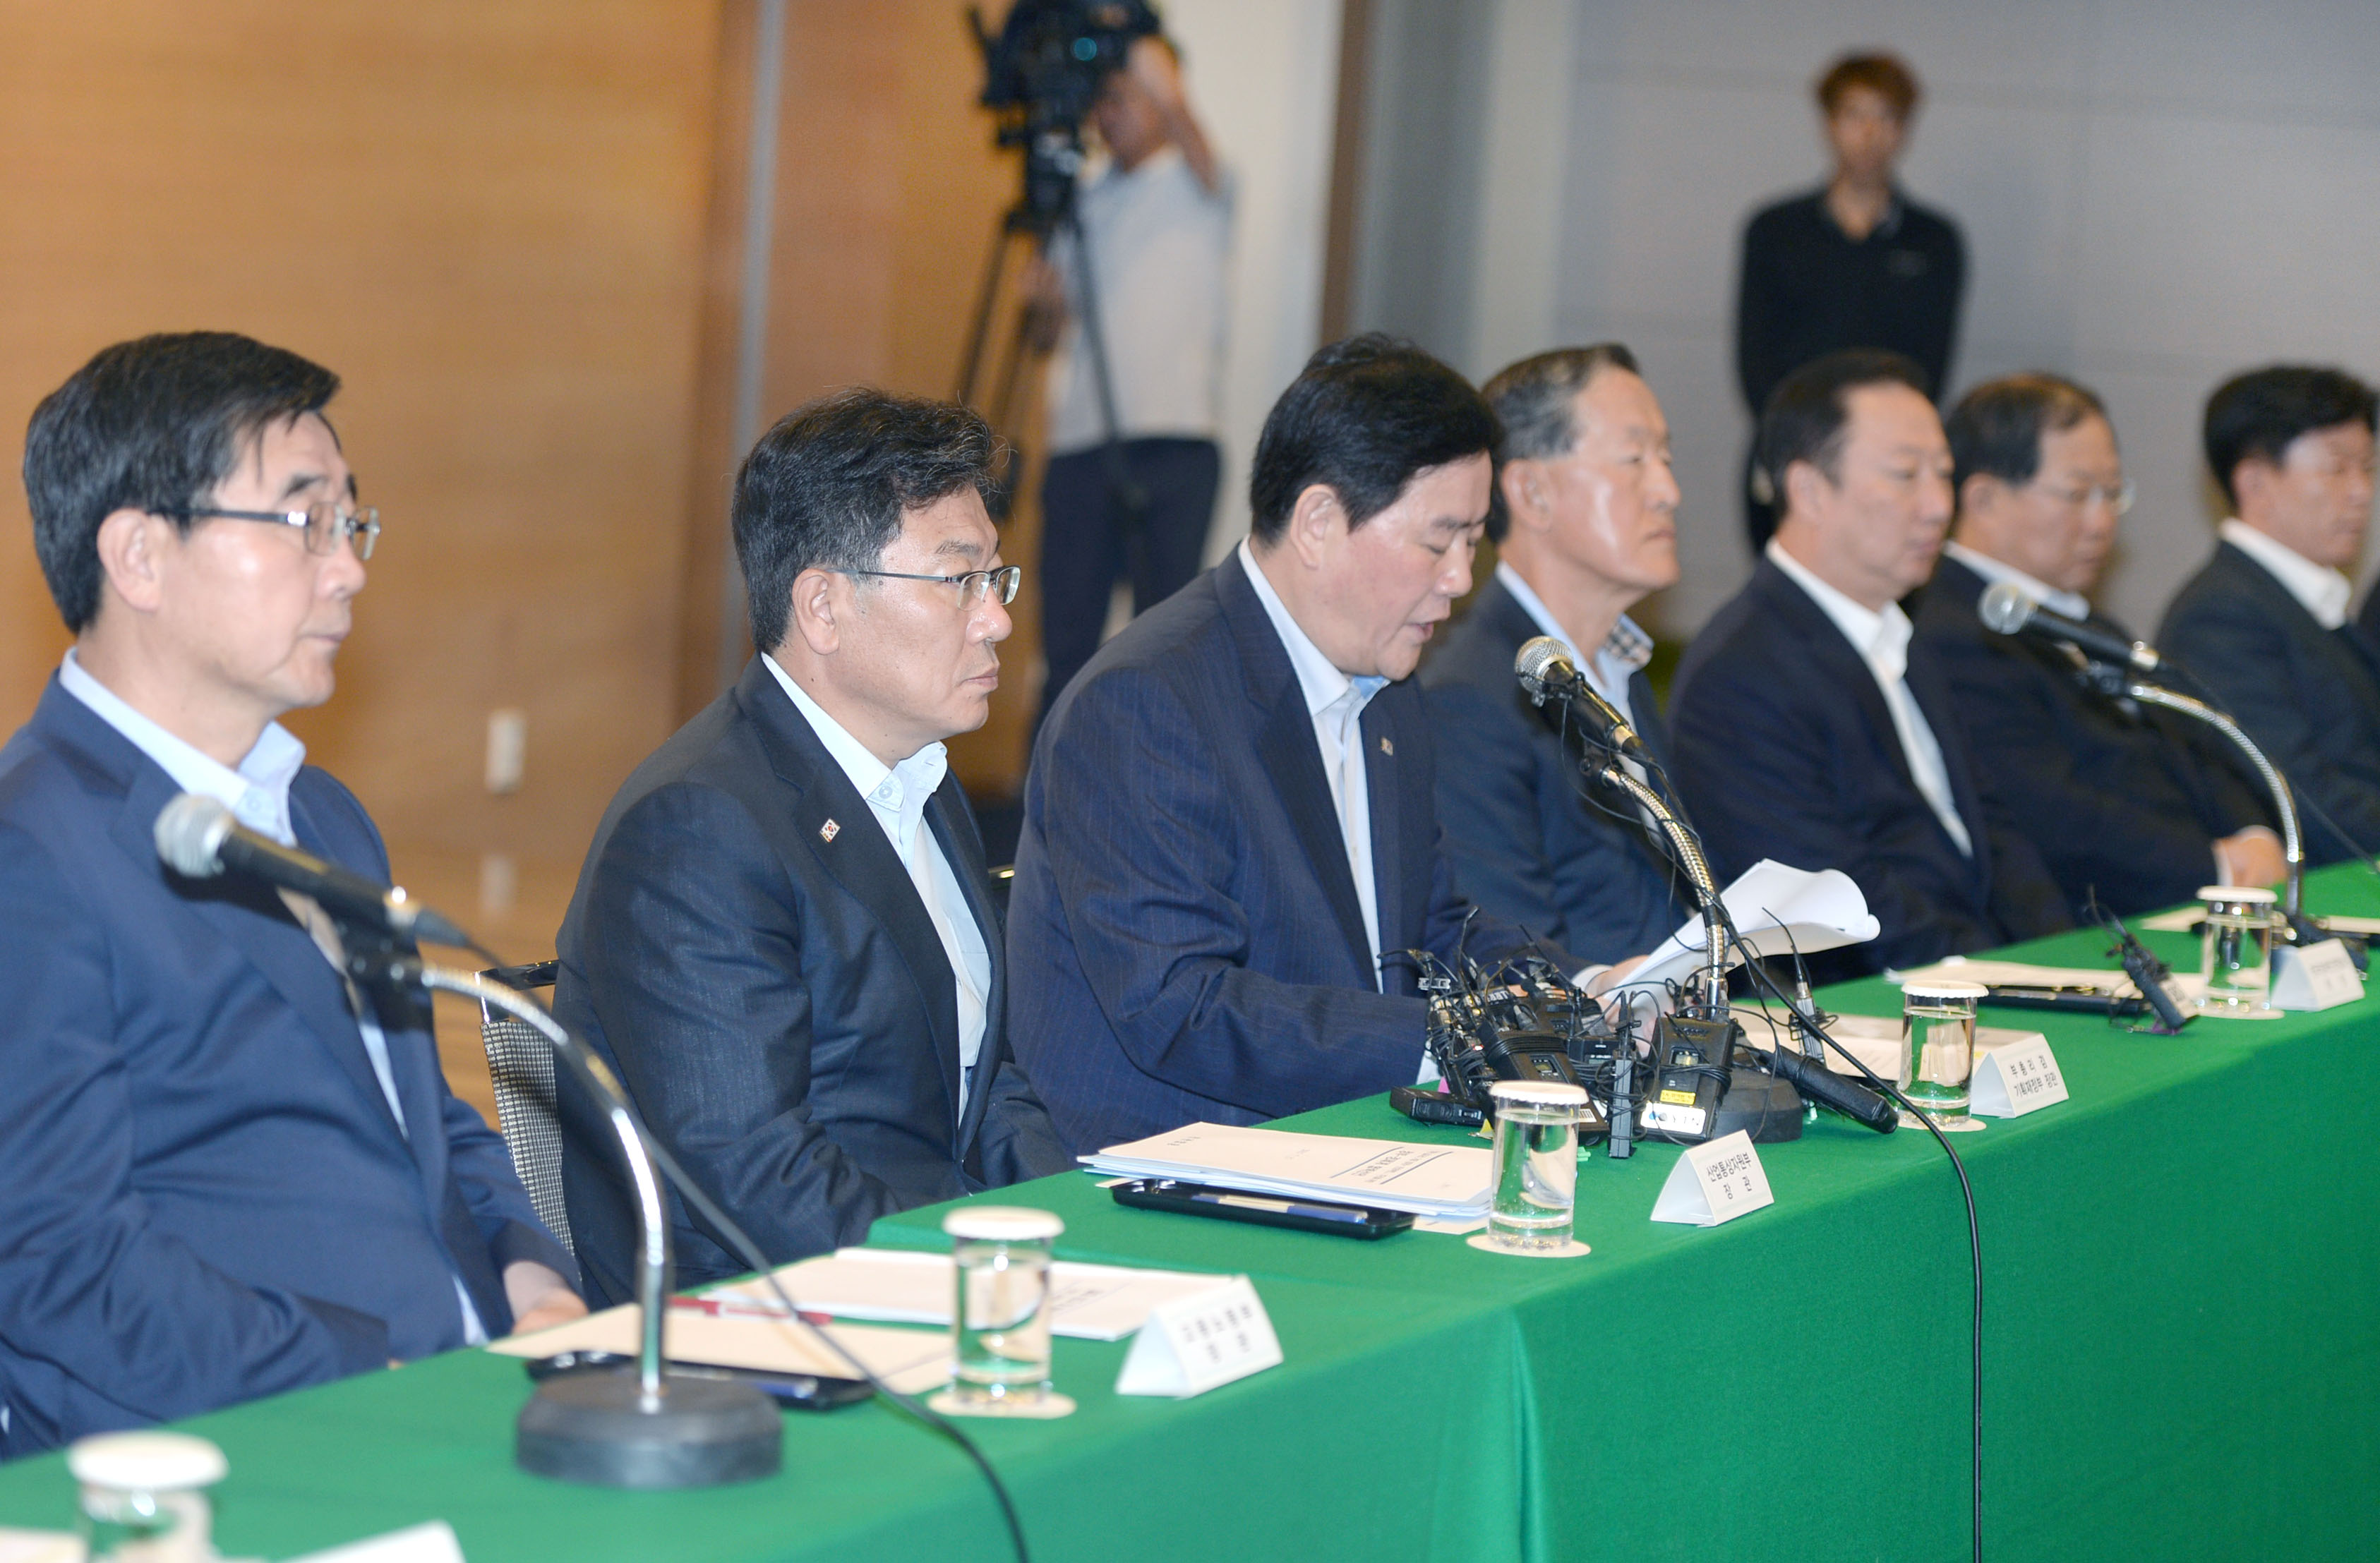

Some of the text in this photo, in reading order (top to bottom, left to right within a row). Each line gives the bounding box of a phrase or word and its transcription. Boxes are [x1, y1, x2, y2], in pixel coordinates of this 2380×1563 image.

[2014, 1072, 2058, 1097] 기획재정부 장관
[1706, 1152, 1752, 1183] 산업통상자원부
